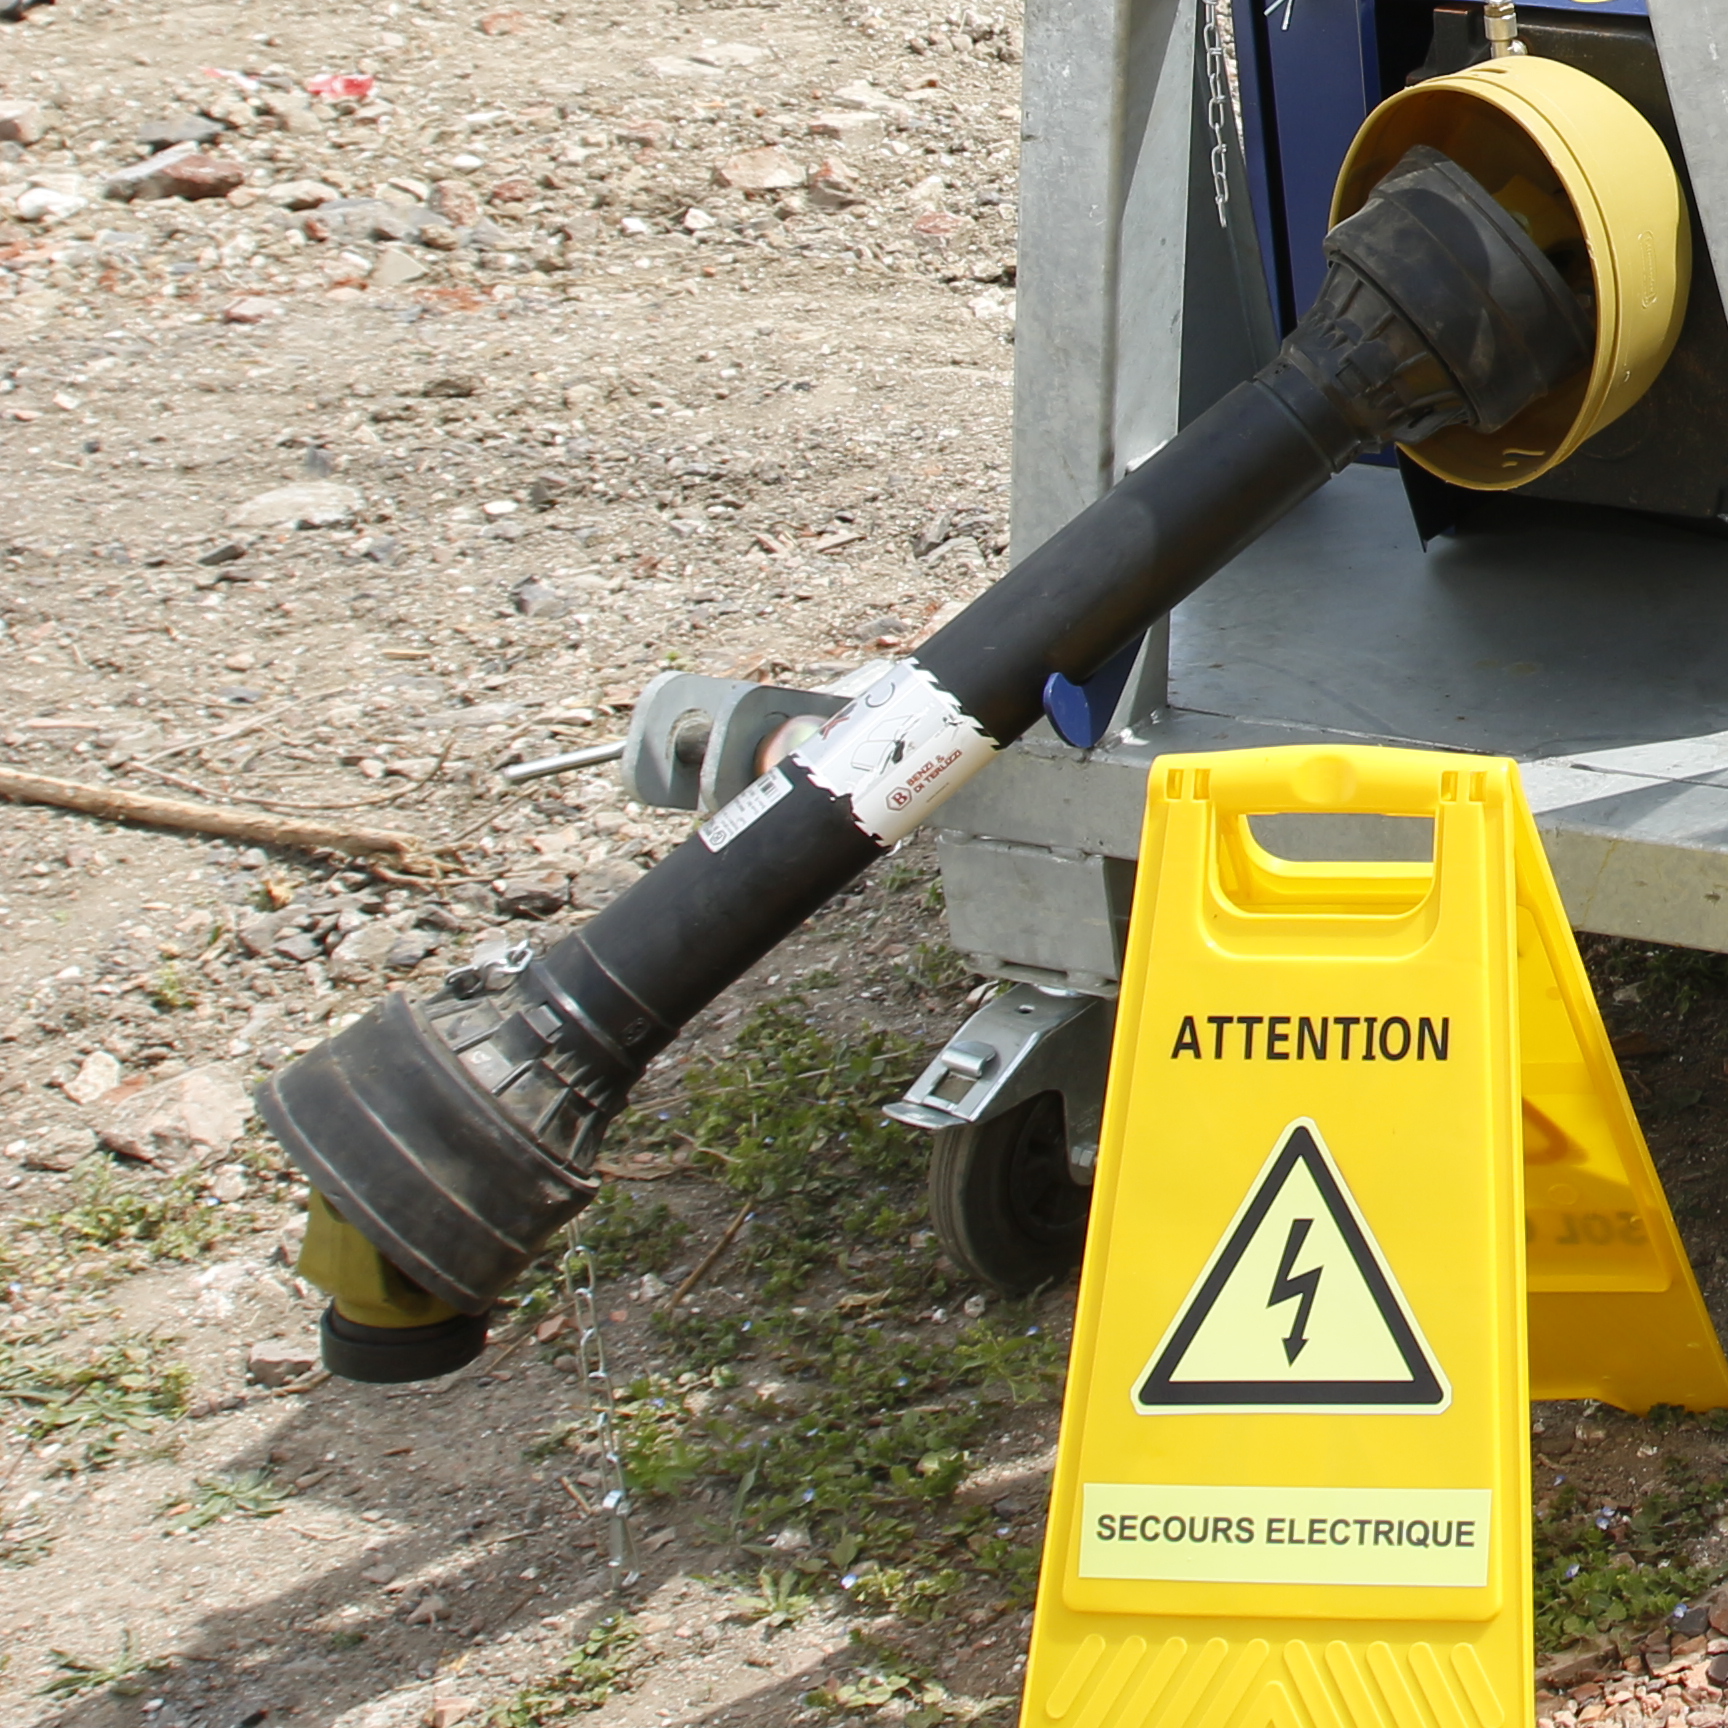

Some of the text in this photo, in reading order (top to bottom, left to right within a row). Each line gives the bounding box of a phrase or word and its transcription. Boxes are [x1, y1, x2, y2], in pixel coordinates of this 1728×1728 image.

[906, 764, 934, 788] BENZI
[1171, 1015, 1450, 1061] ATTENTION
[1096, 1513, 1476, 1550] SECOURS ELECTRIQUE
